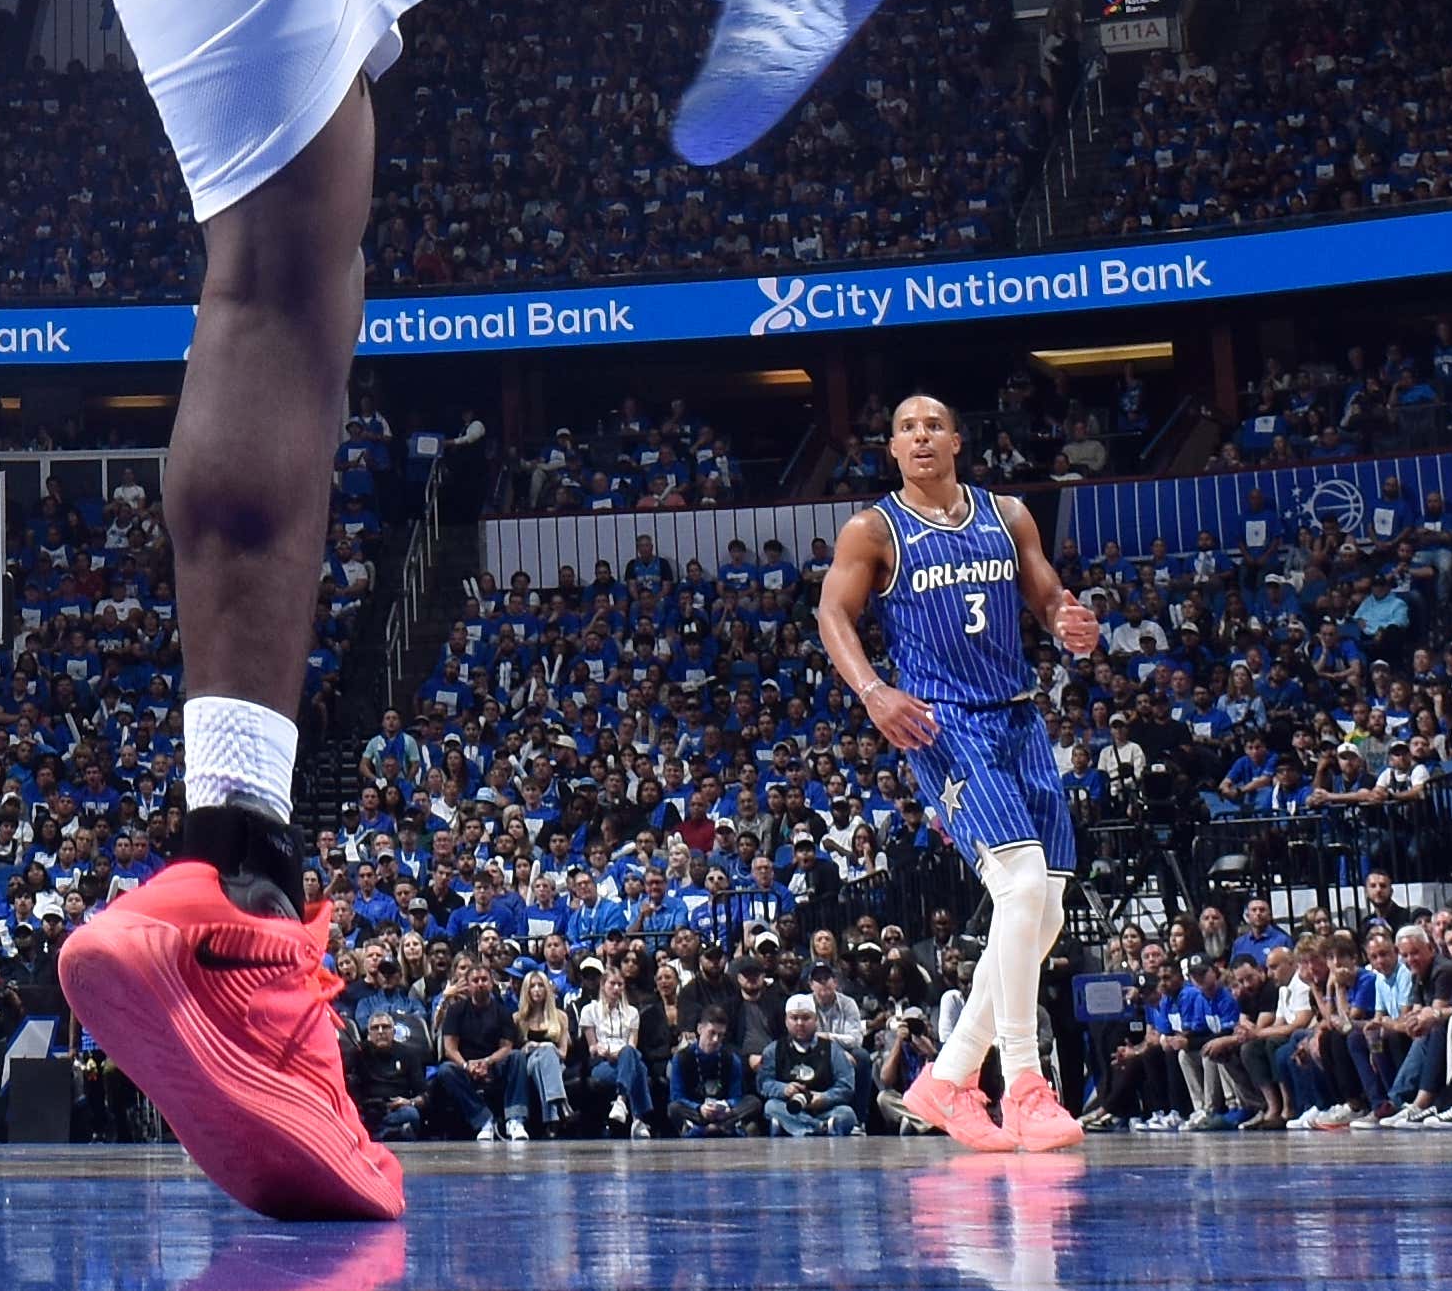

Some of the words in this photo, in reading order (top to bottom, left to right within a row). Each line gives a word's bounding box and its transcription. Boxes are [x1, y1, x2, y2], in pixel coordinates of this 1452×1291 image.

[1109, 21, 1160, 41] 111A
[806, 286, 893, 325] City
[907, 266, 1089, 312] National
[1100, 255, 1212, 295] Bank
[527, 301, 634, 335] Bank
[965, 593, 985, 634] 3
